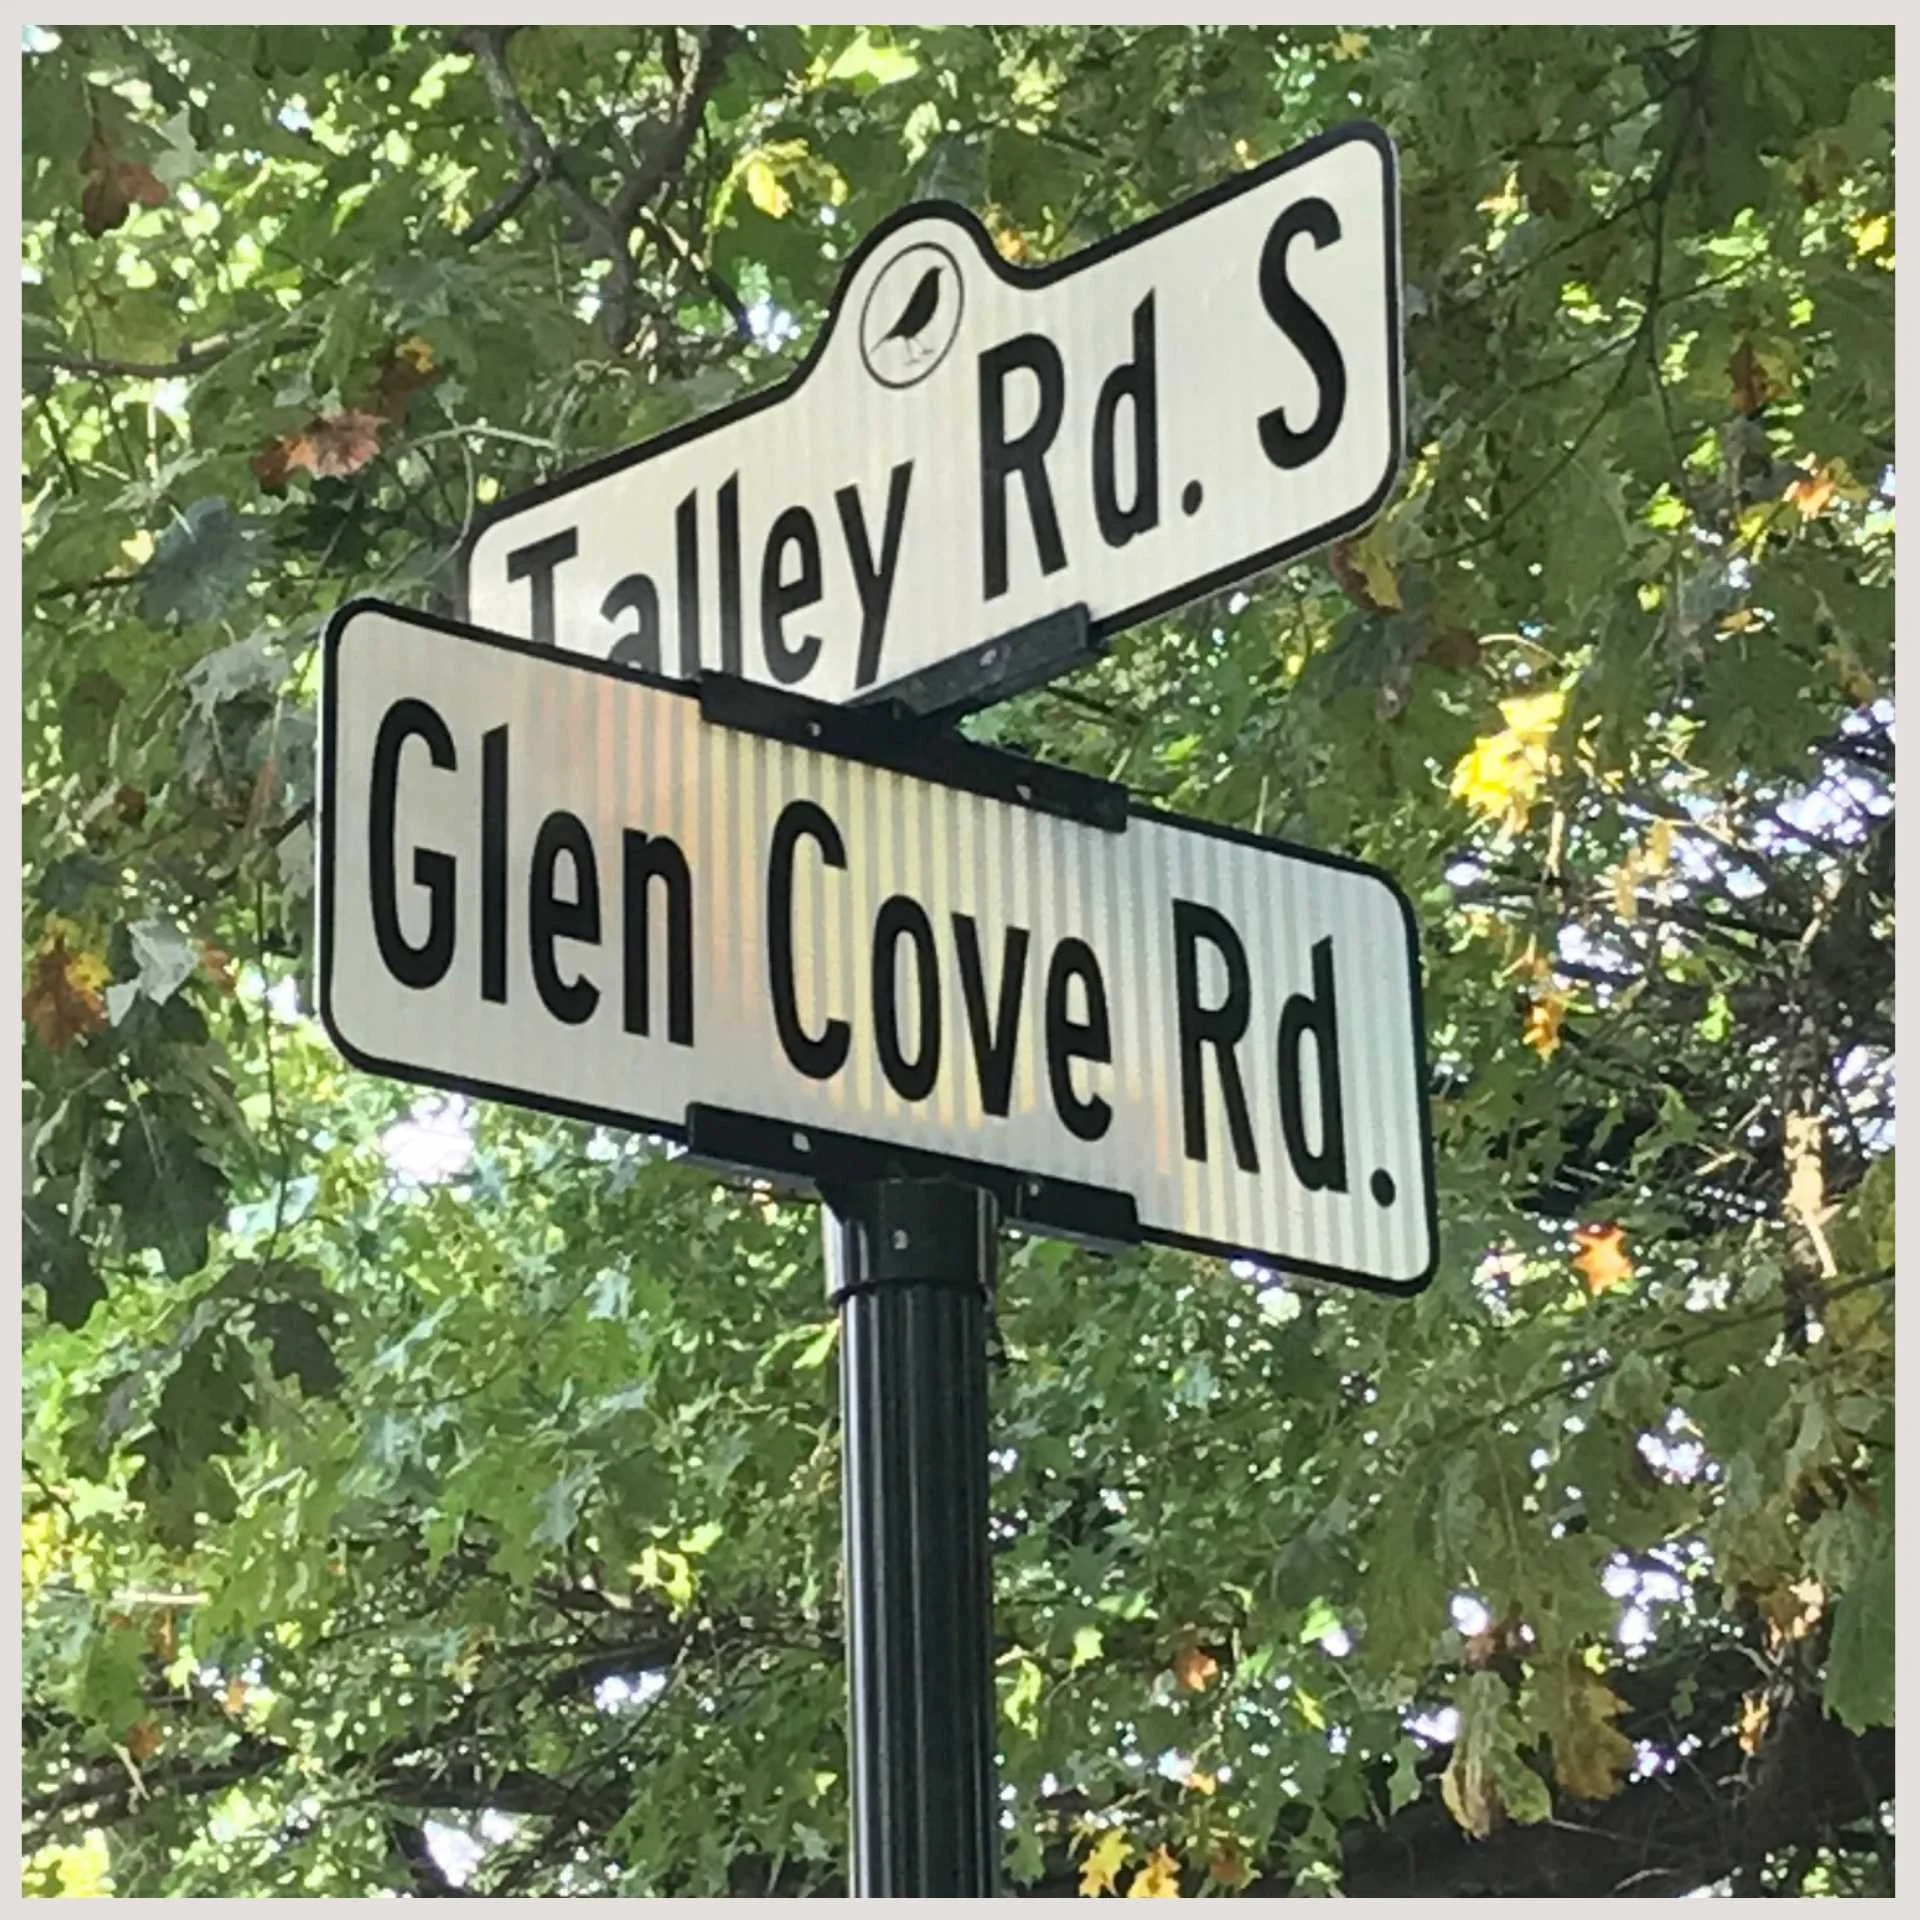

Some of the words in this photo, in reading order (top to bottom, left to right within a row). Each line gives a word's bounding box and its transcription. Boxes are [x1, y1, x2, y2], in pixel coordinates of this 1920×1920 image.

[507, 460, 914, 690] Talley
[978, 287, 1204, 602] Rd.
[1257, 196, 1348, 471] S
[367, 697, 694, 1049] Glen
[766, 799, 1113, 1143] Cove
[1170, 897, 1397, 1209] Rd.
